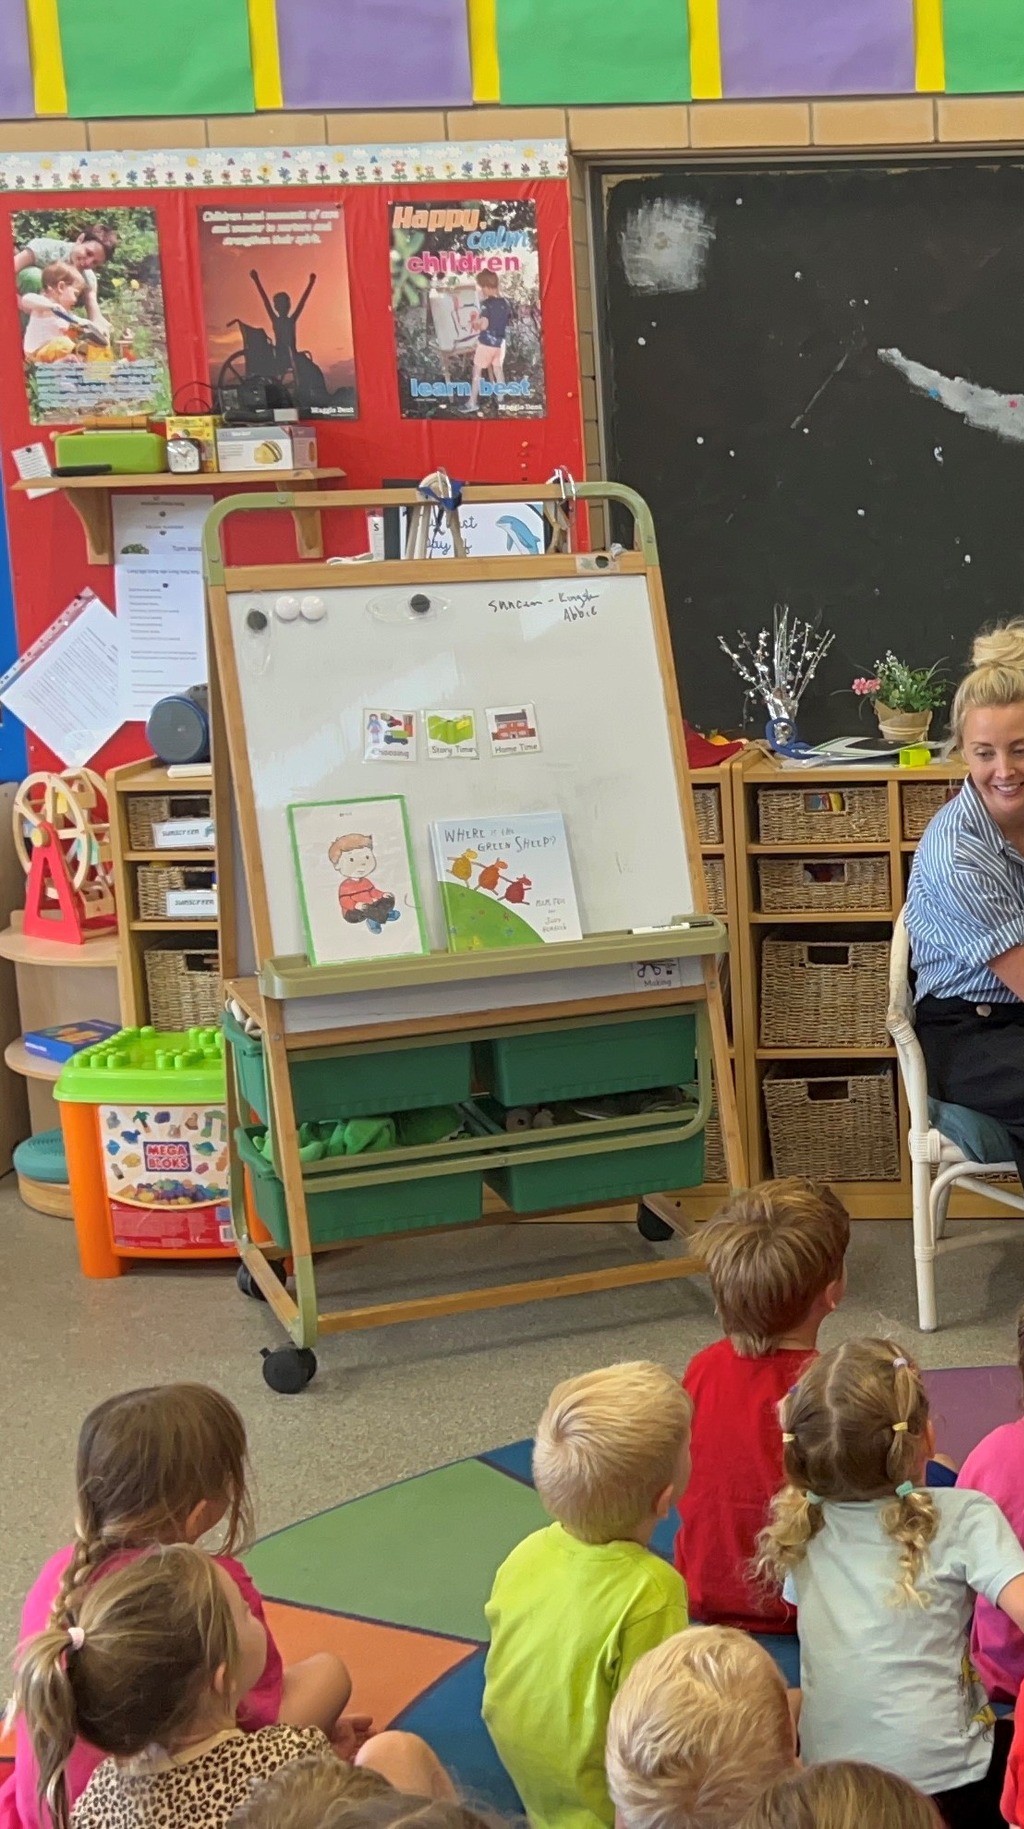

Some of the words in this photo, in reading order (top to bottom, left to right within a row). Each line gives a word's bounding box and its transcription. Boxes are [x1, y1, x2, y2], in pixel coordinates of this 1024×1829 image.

[466, 226, 530, 250] calm
[406, 251, 521, 273] children
[410, 378, 472, 398] learn
[478, 376, 534, 398] best
[432, 745, 452, 756] Story
[455, 745, 474, 754] Time
[495, 746, 517, 755] Home
[519, 743, 538, 752] Time
[444, 826, 486, 843] WHERE
[477, 842, 512, 852] GREEN
[148, 1145, 188, 1156] MEGA
[149, 1158, 189, 1169] BLOKS
